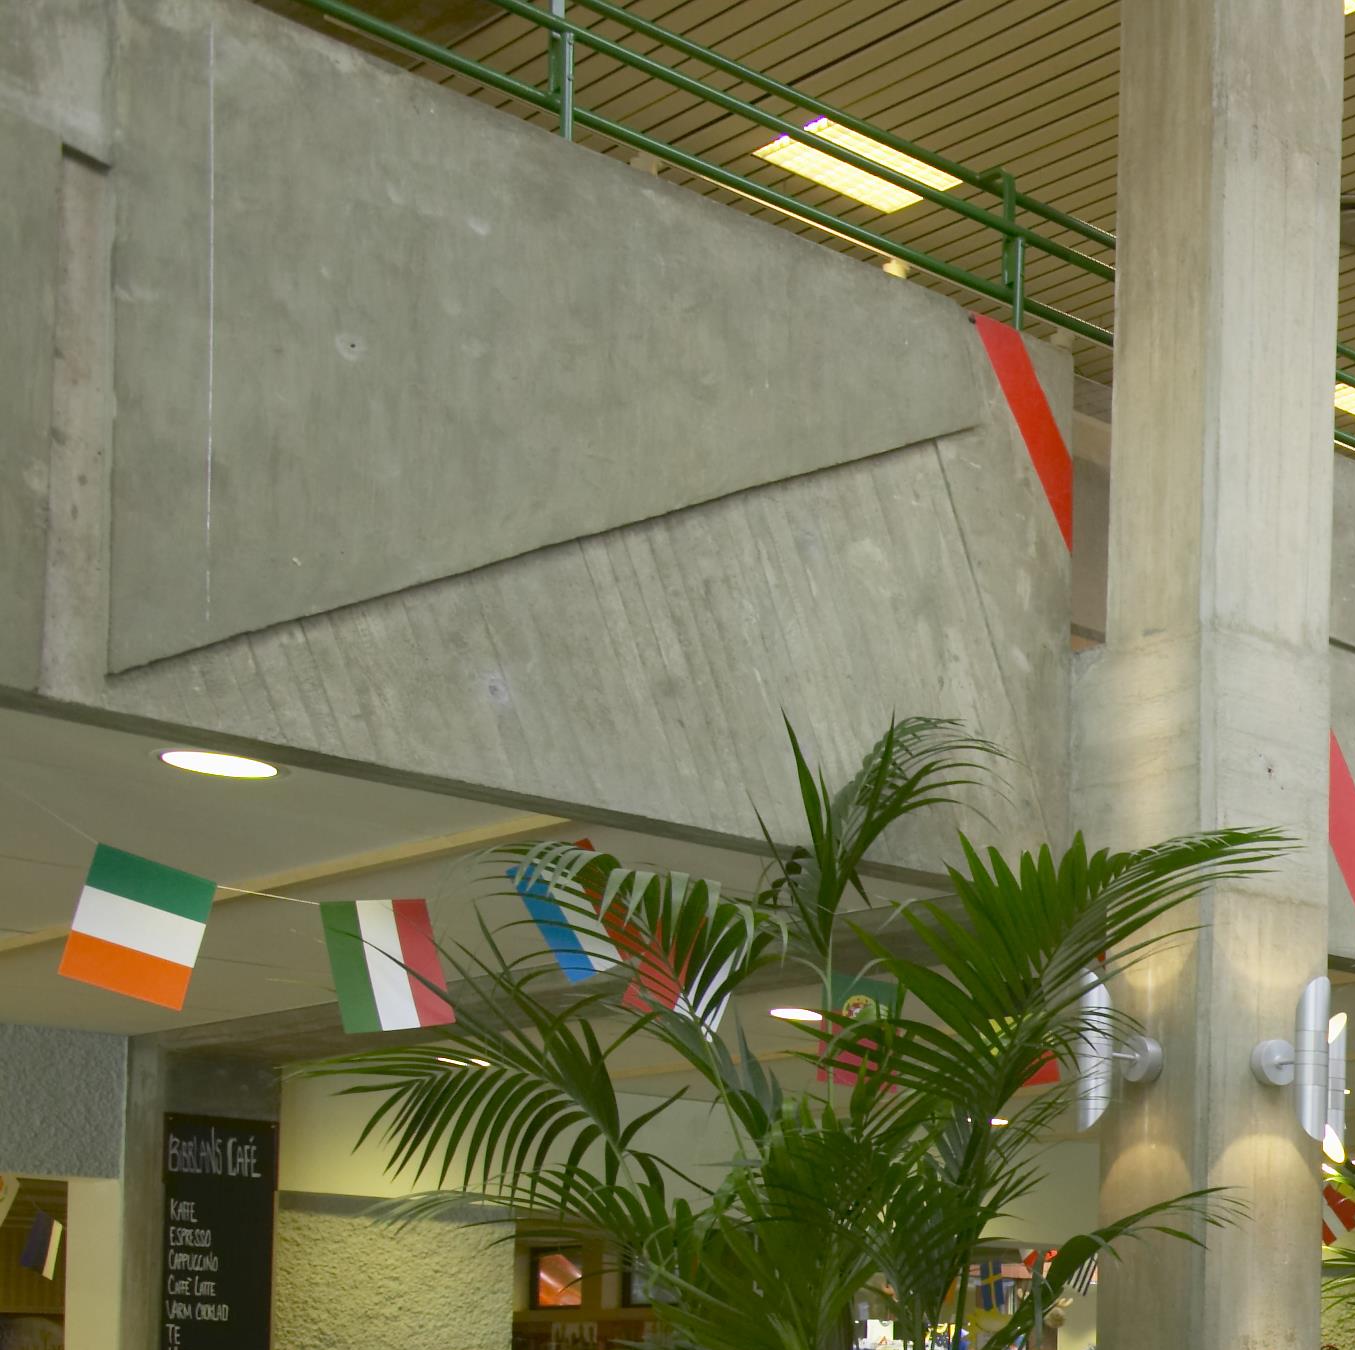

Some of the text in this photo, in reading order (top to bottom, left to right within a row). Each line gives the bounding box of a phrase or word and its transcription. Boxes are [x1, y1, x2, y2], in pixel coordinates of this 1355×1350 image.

[170, 1197, 198, 1223] KAFFE
[169, 1226, 212, 1248] ESPRESSO
[168, 1249, 219, 1272] CAPPUCCINO
[194, 1275, 217, 1296] LATTE
[165, 1300, 193, 1319] VARM
[165, 1323, 181, 1345] TE
